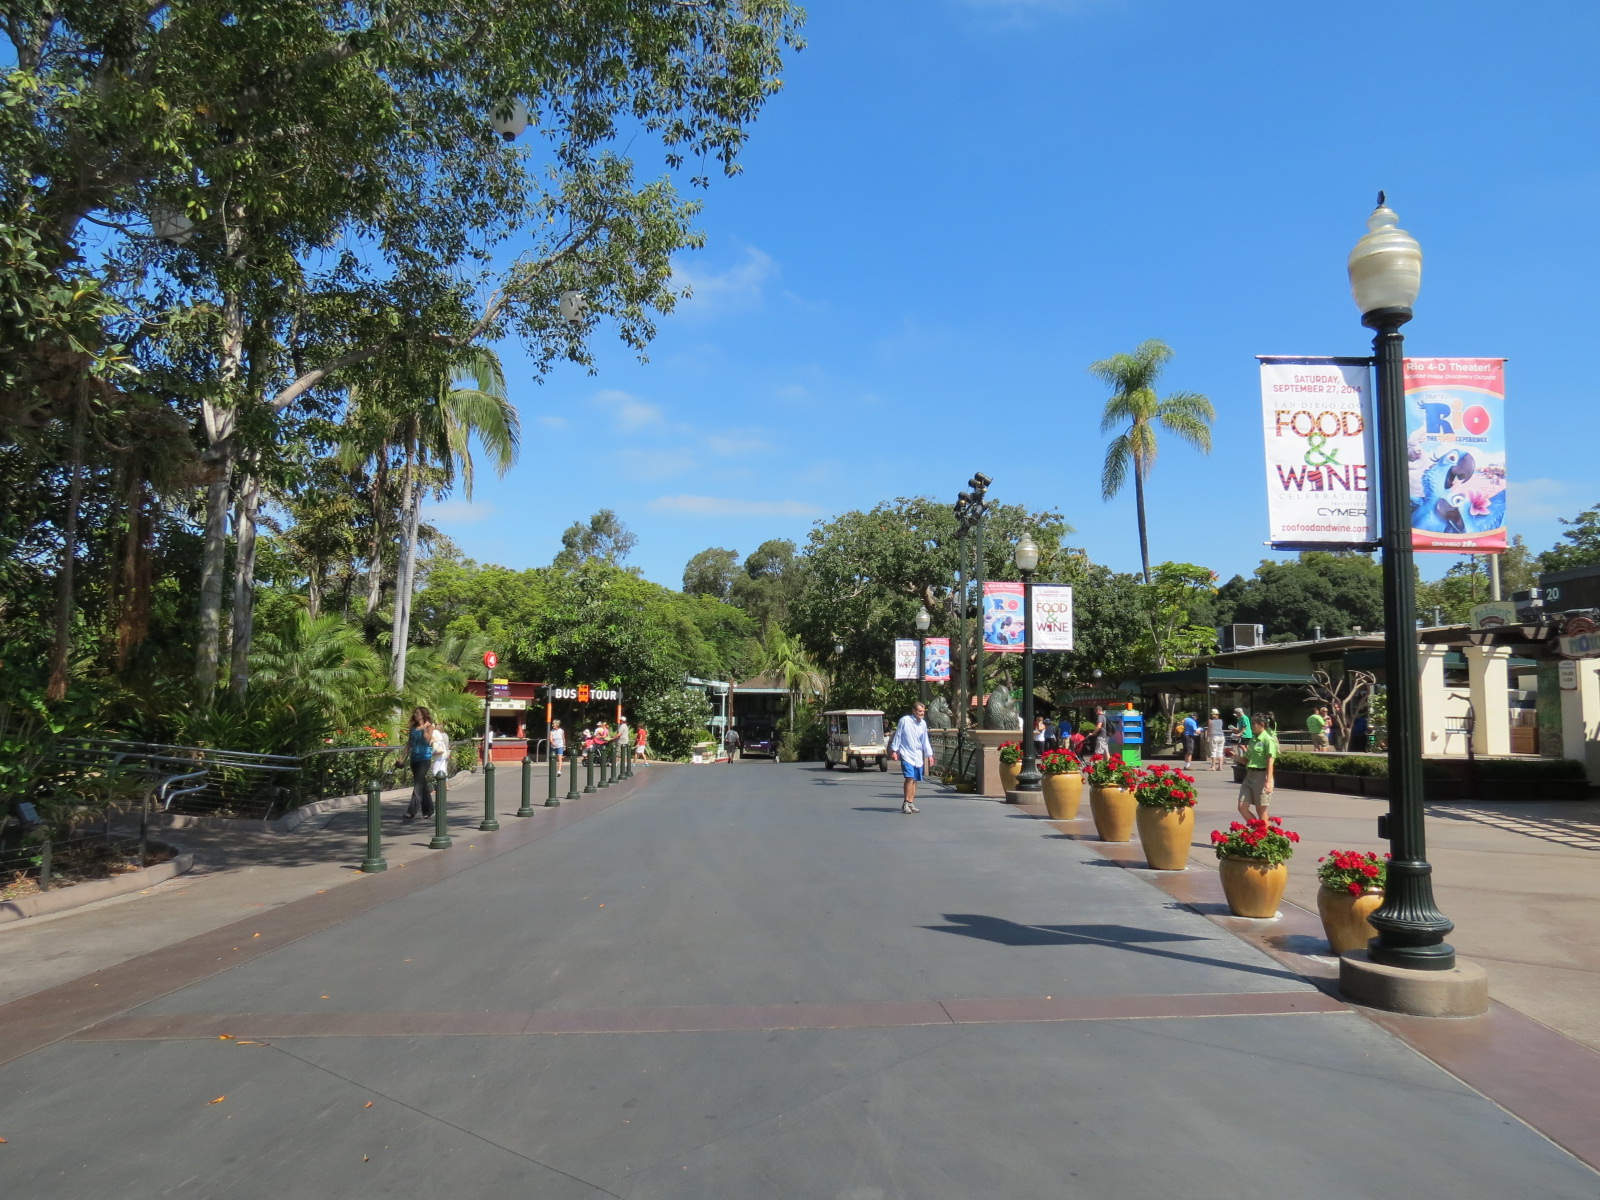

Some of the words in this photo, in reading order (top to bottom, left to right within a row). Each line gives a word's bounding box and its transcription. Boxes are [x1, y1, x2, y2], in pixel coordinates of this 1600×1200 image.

[1406, 362, 1425, 371] Rio
[1427, 362, 1446, 371] 4-D
[1449, 362, 1491, 372] Theater!
[1294, 375, 1340, 385] SATURDAY,
[1273, 384, 1323, 393] SEPTEMBER
[1326, 386, 1339, 394] 27,
[1341, 386, 1362, 394] 2014
[1275, 410, 1364, 437] FOOD
[1304, 432, 1342, 466] &
[1276, 464, 1369, 492] WINE
[1281, 524, 1370, 533] zoofoodandwine.com
[1546, 587, 1559, 600] 20
[1036, 602, 1068, 613] FOOD
[1046, 610, 1059, 623] &
[1036, 622, 1069, 632] WINE
[555, 688, 577, 699] BUS
[590, 689, 617, 700] TOUR
